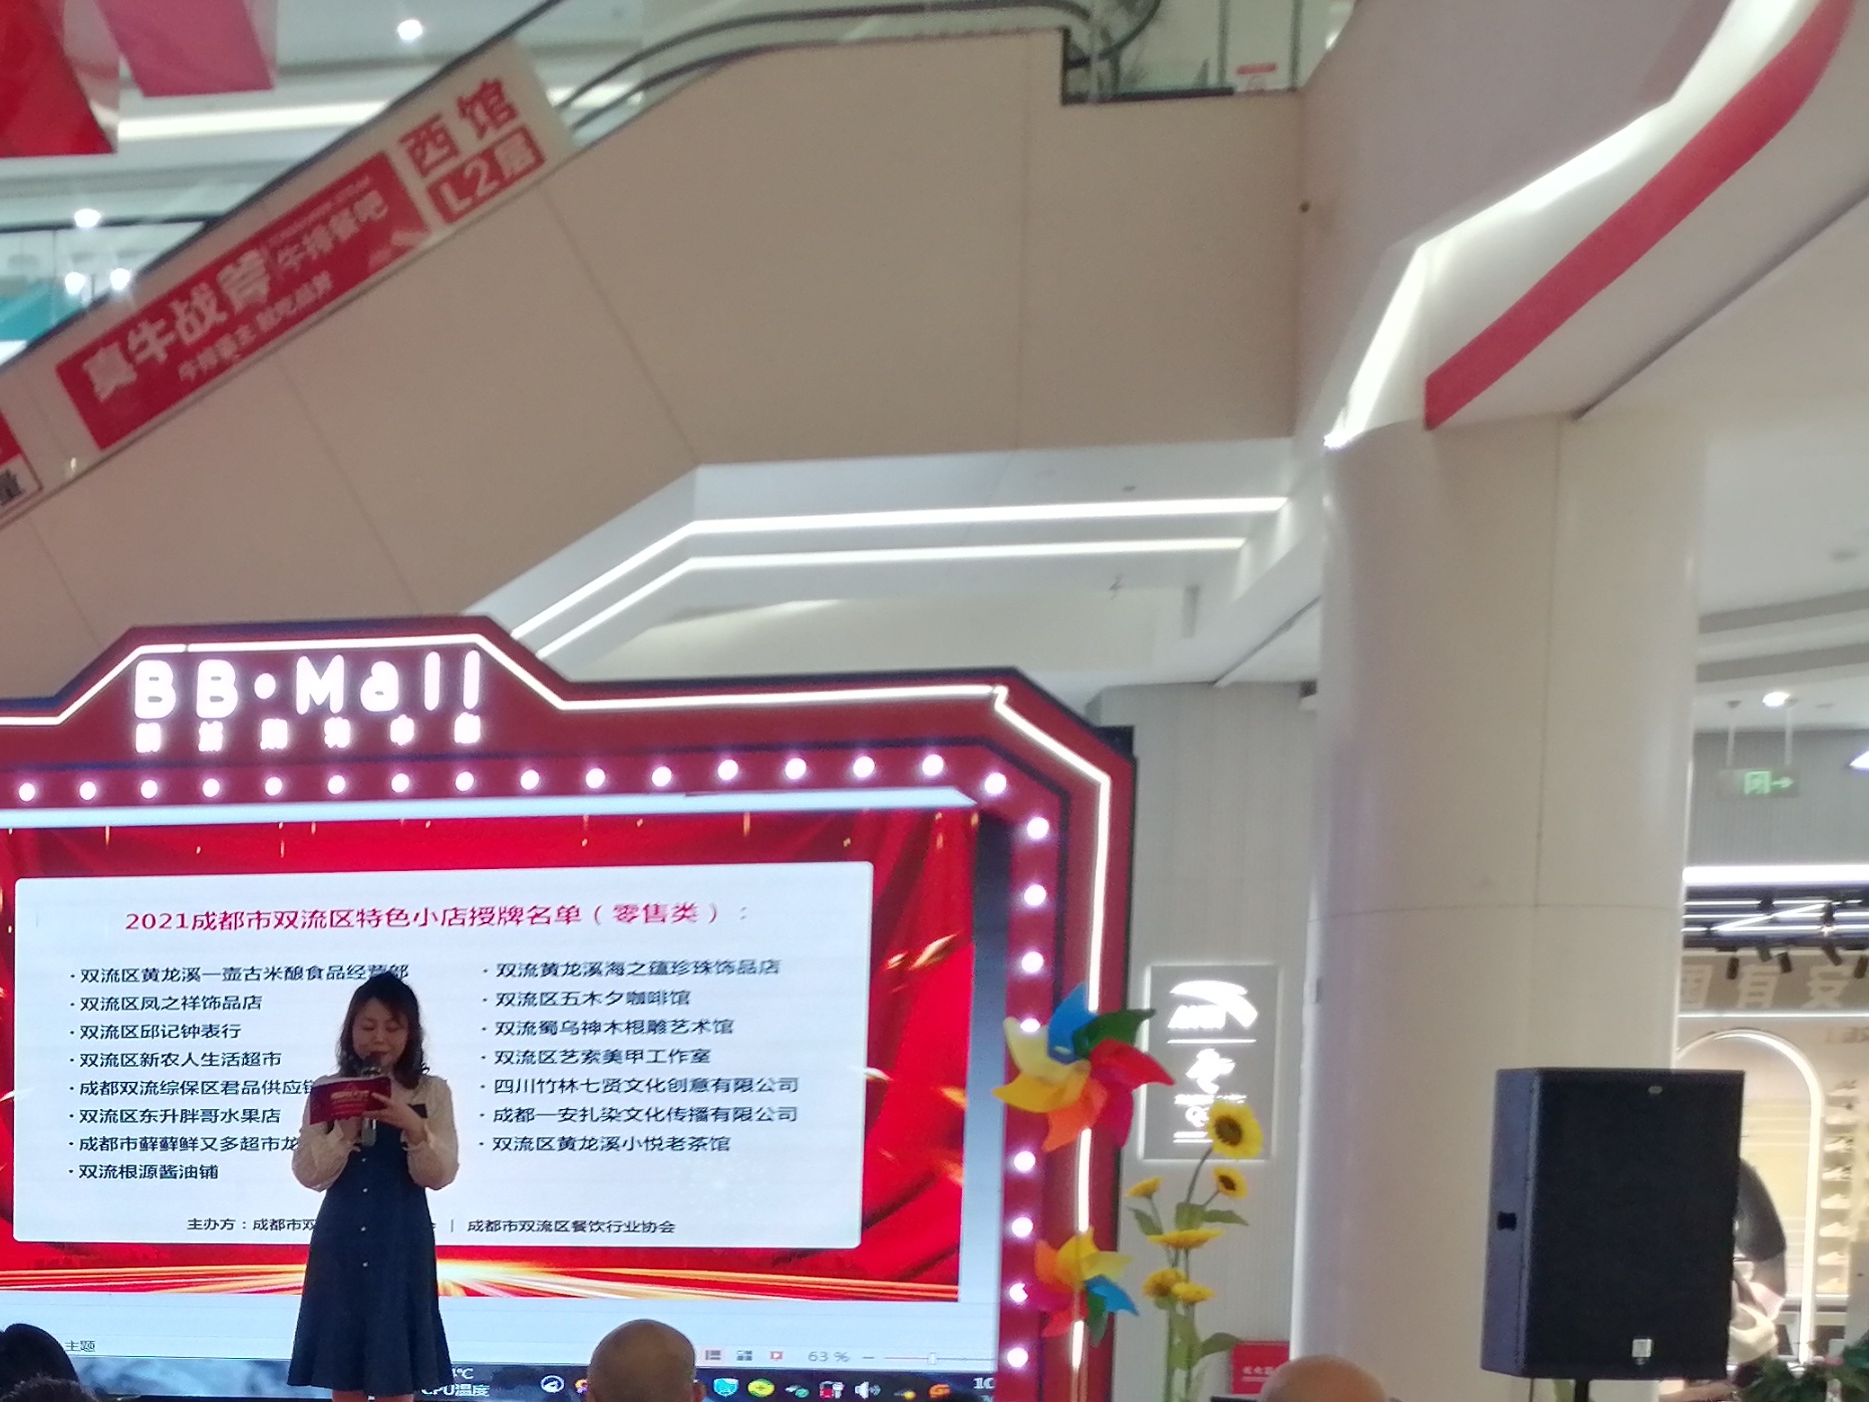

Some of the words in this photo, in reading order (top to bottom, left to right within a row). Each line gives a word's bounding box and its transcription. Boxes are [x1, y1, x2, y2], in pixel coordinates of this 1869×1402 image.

[400, 77, 519, 177] 西馆
[438, 133, 537, 215] L2层
[80, 1023, 242, 1040] 双流区邱记钟表行
[79, 1051, 282, 1068] 双流区新农人生活超市
[494, 1077, 799, 1095] 四川竹林七贤文化创意有限公司
[79, 1108, 281, 1124] 双流区东升胖哥水果店
[492, 1135, 732, 1152] 双流区黄龙溪小悦老茶馆
[78, 1164, 219, 1180] 双流根源酱油铺
[468, 1219, 676, 1233] 成都市双流区餐饮行业协会
[64, 1340, 97, 1353] 主题
